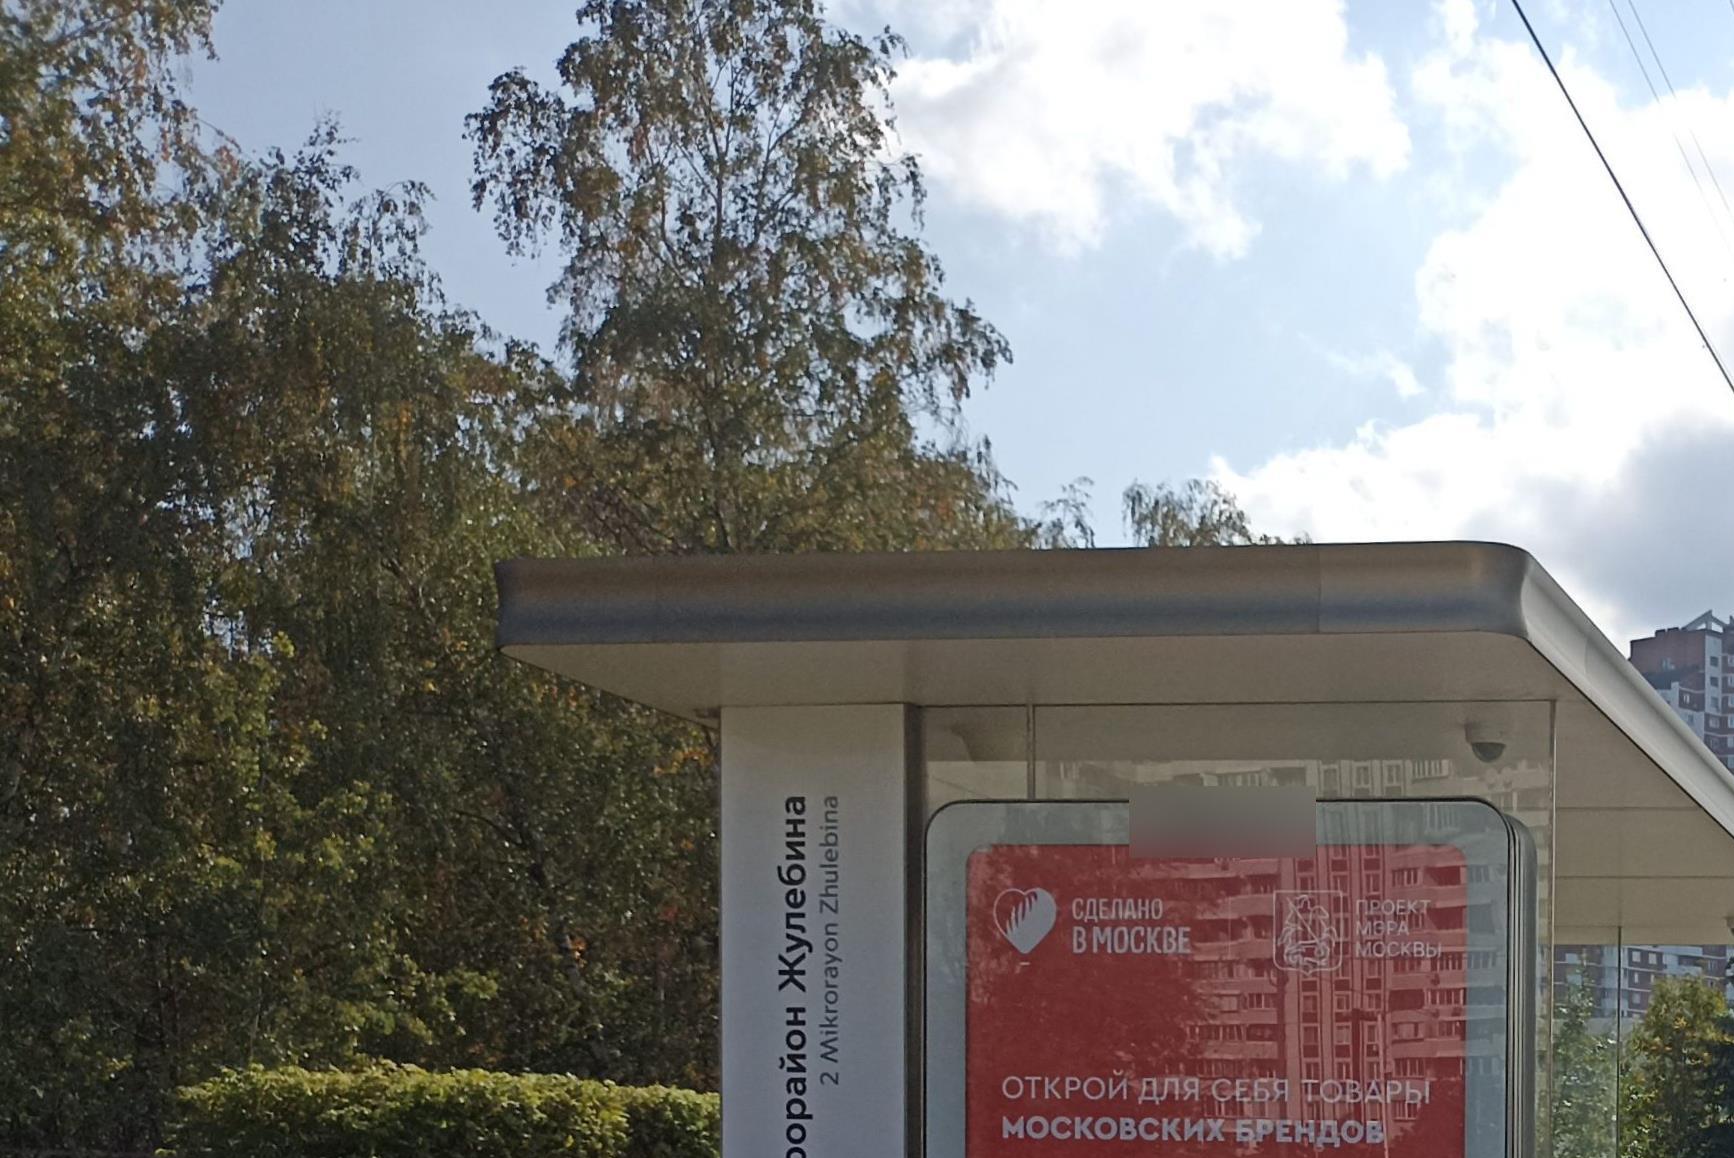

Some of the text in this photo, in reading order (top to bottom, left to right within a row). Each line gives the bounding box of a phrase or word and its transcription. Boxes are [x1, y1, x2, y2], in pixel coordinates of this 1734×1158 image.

[776, 795, 814, 993] Жулебина
[1356, 899, 1431, 916] ПРОЕКТ
[1071, 898, 1164, 923] СДЕЛАНО
[818, 795, 843, 1086] 2 Mikrorayon Zhulebina
[1072, 925, 1192, 954] В МОСКВЕ
[1356, 920, 1410, 937] МЭРА
[1356, 941, 1442, 959] МОСКВЫ
[1002, 1068, 1430, 1105] ОТКРОЙ ДЛЯ СЕБЯ ТОВАРЫ
[1002, 1115, 1385, 1148] МОСКОВСКИХ БРЕНДОВ
